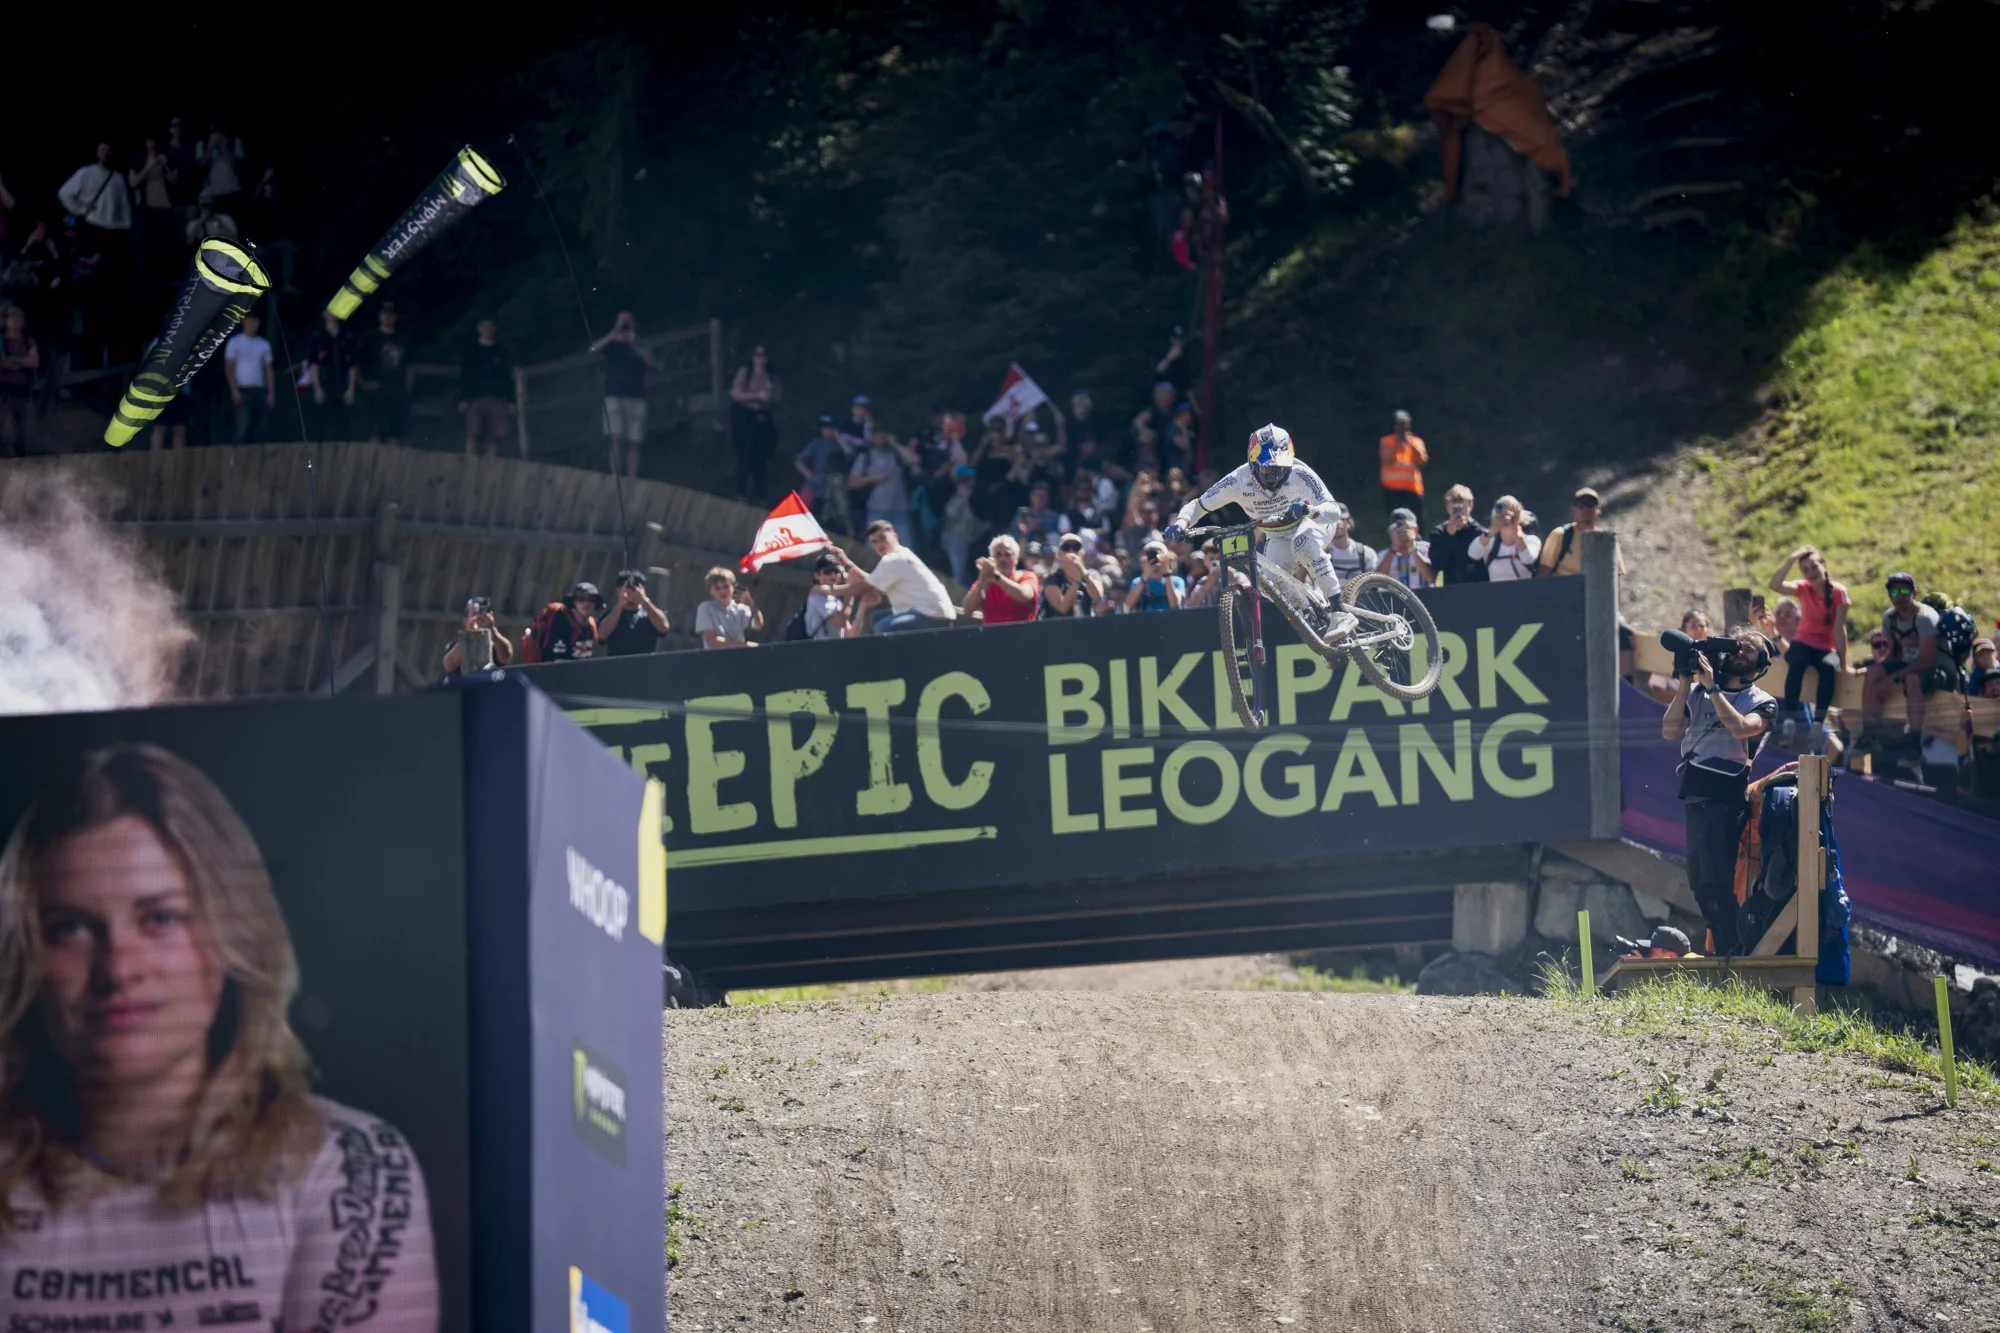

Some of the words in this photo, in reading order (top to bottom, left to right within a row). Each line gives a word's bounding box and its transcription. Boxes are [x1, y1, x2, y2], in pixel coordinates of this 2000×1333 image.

[381, 194, 447, 259] MONSTER
[1043, 622, 1550, 746] BIKEPARK
[684, 671, 996, 834] EPIC
[1048, 712, 1555, 835] LEOGANG
[565, 845, 629, 943] WHOOP
[13, 1254, 256, 1301] COMMENCAL
